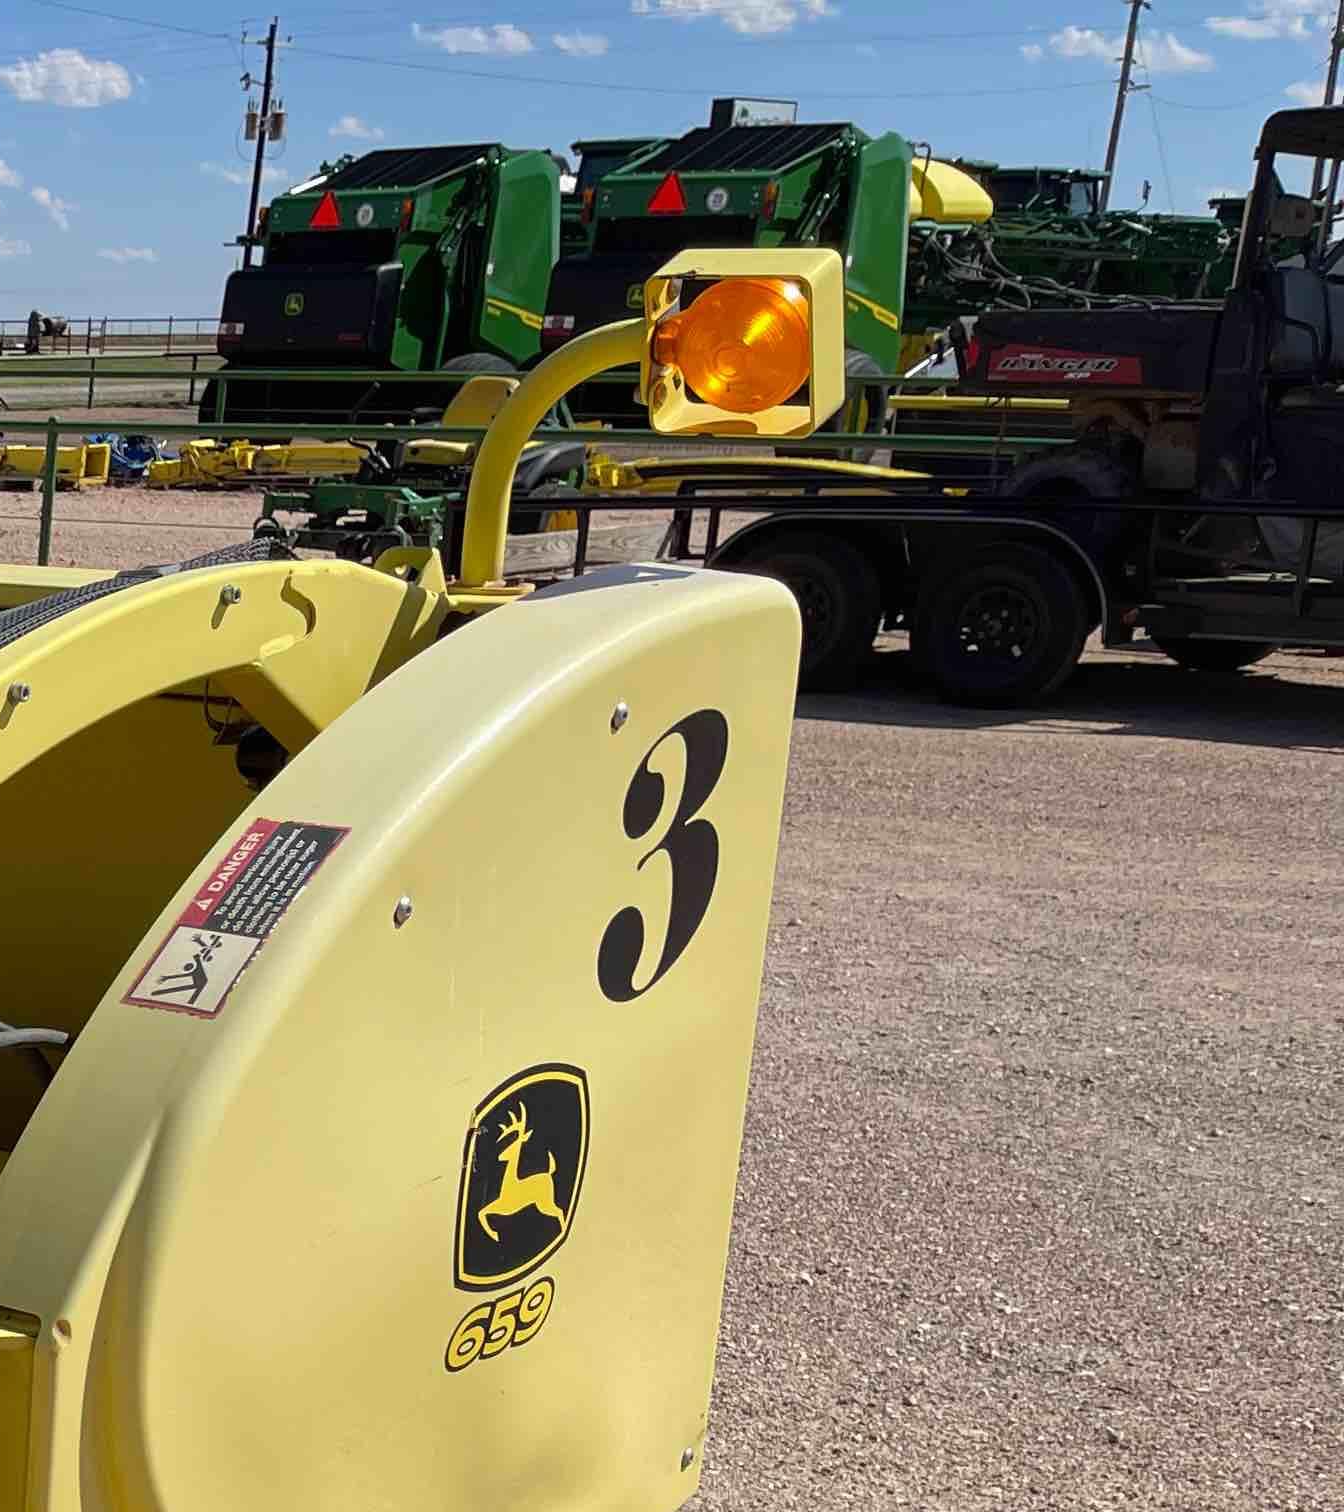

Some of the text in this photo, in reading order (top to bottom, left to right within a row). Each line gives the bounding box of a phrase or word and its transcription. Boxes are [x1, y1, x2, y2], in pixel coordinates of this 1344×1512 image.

[208, 831, 264, 892] DANGER
[597, 708, 729, 1002] 3
[215, 906, 227, 915] To
[445, 1276, 555, 1372] 659
